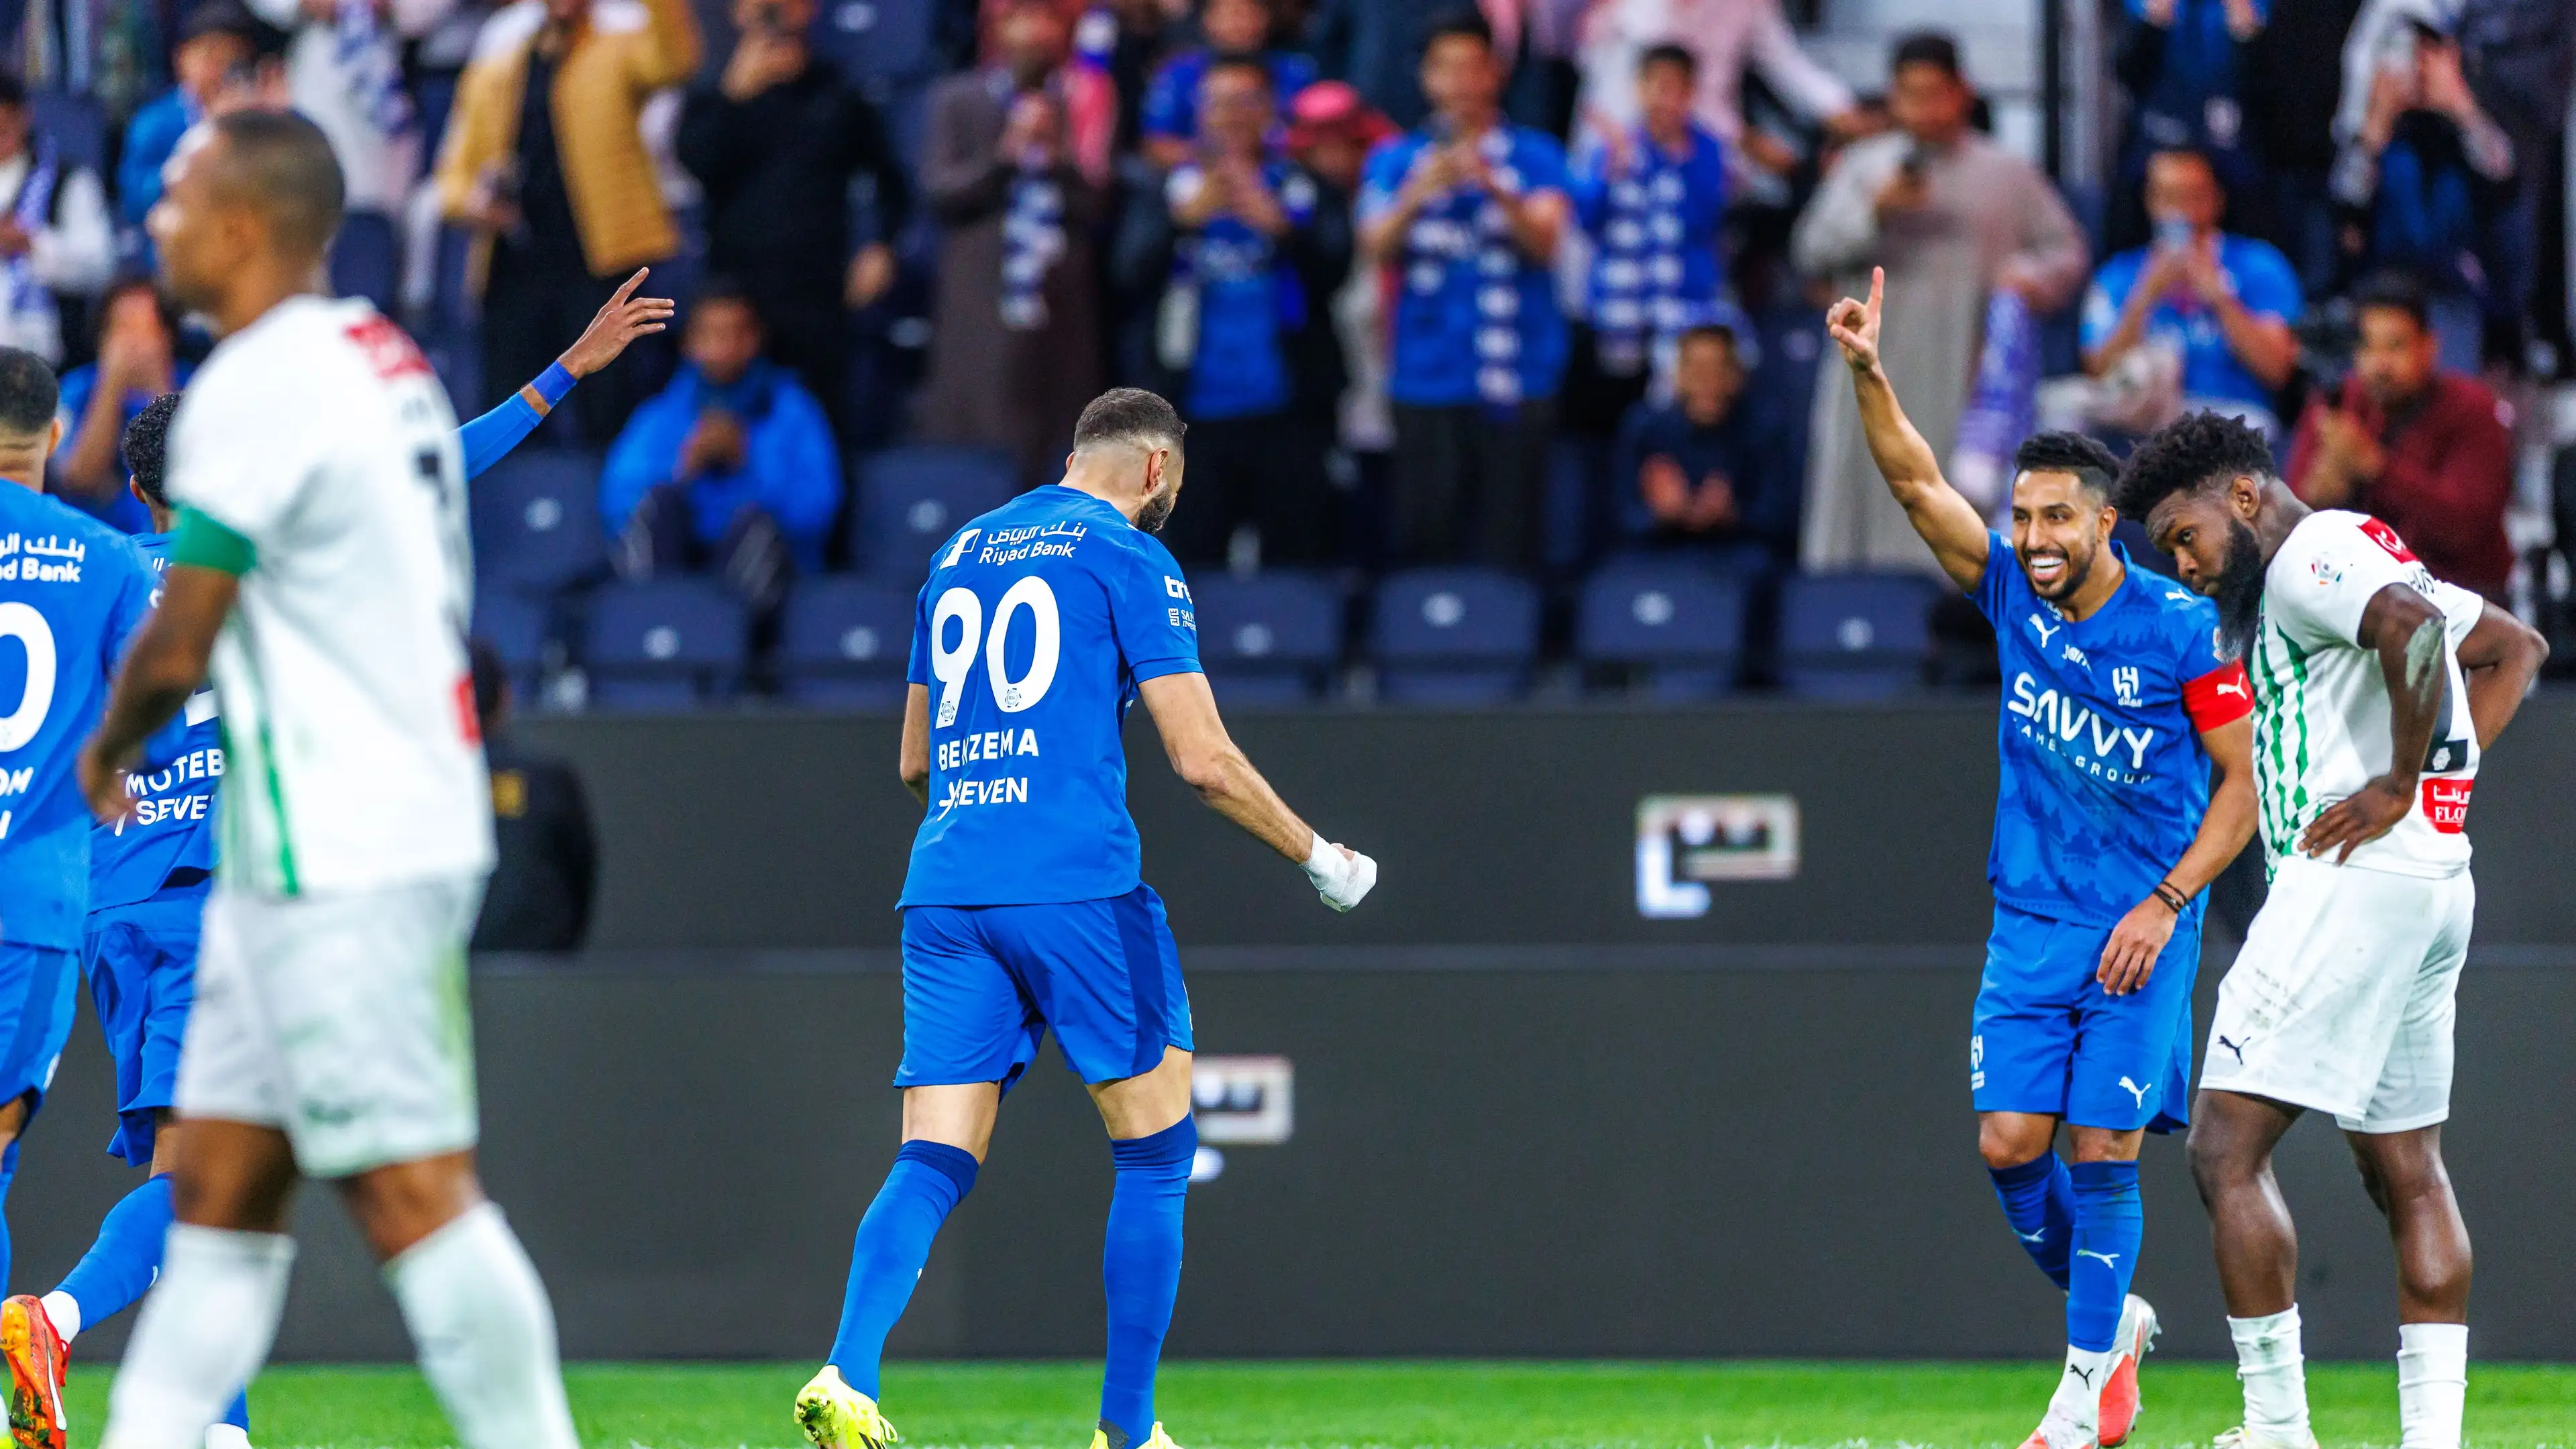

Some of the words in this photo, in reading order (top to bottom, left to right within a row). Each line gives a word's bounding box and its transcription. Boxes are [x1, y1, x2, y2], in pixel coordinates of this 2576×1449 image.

[1040, 521, 1087, 541] بنك
[21, 557, 81, 582] Bank
[978, 544, 1030, 566] Riyad
[1030, 541, 1076, 558] Bank
[931, 576, 1061, 729] 90
[0, 602, 56, 752] 0
[2008, 672, 2154, 769] SAVVY
[2012, 715, 2068, 758] AME
[938, 728, 1039, 771] BENZEMA
[125, 748, 227, 798] MOTEB
[136, 794, 215, 826] SEVE
[2434, 806, 2467, 821] FLO
